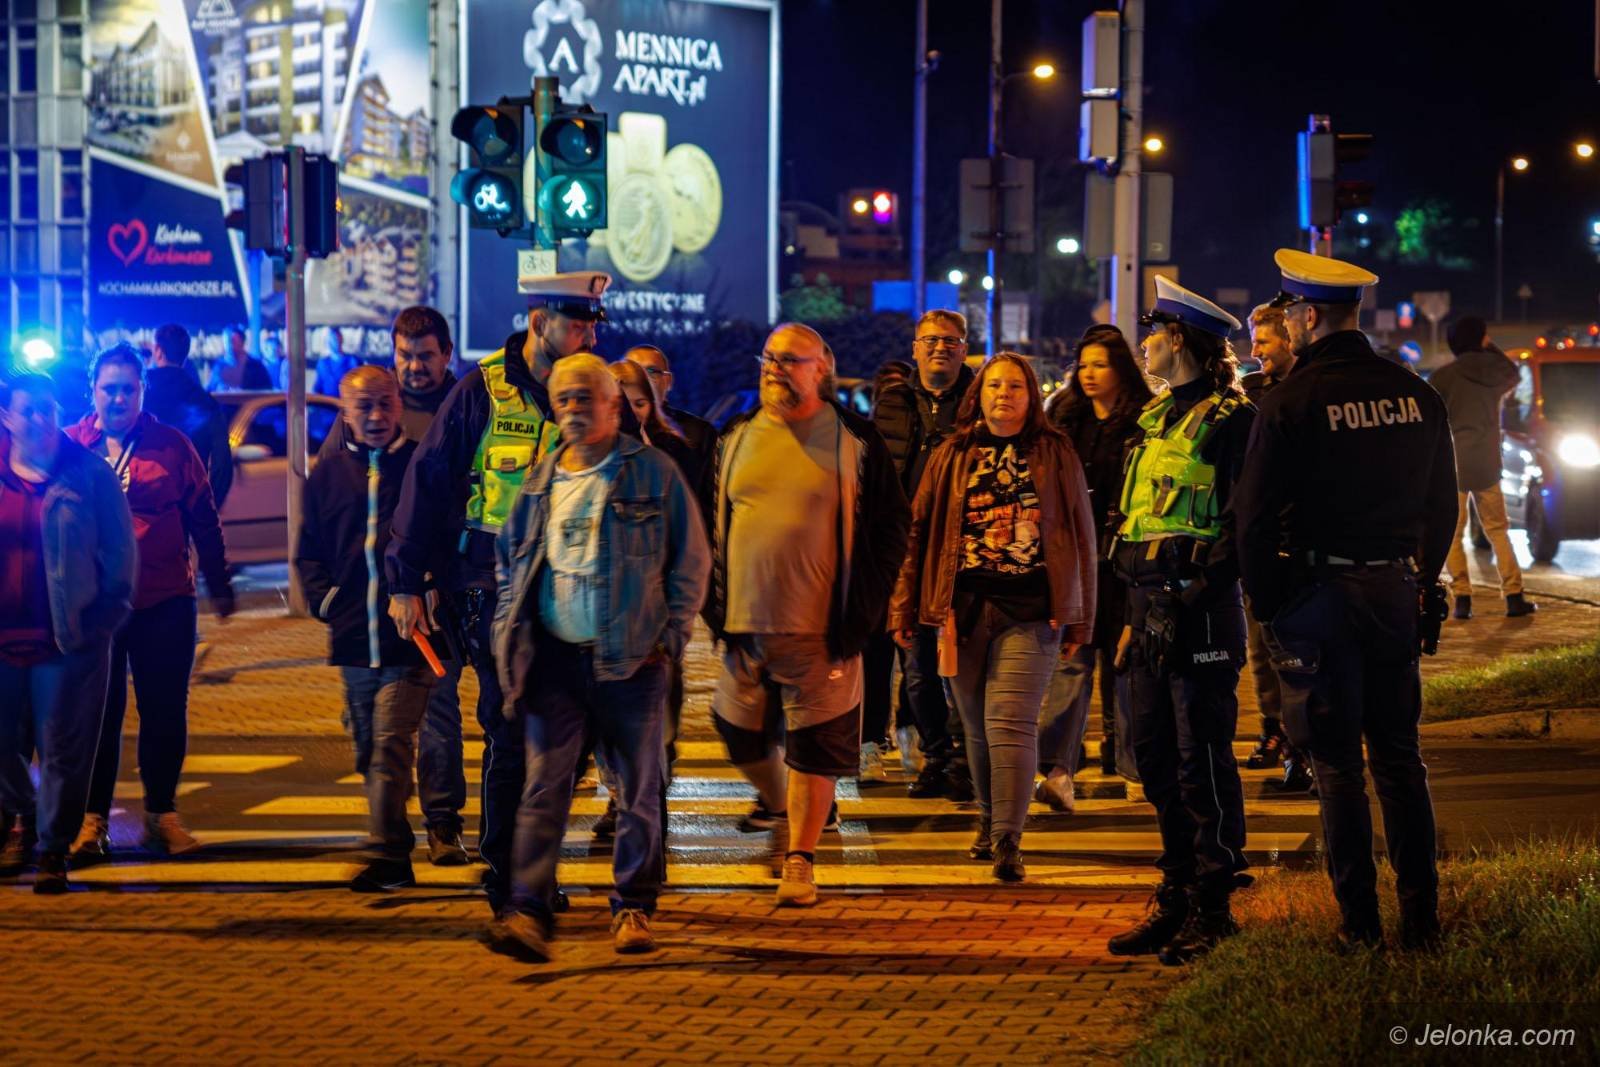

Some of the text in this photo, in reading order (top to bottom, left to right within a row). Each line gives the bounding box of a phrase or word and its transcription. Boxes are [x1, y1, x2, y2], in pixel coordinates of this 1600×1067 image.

[615, 29, 723, 72] MENNICA
[1326, 396, 1424, 431] POLICJA
[496, 420, 536, 434] POLICJA
[1192, 650, 1230, 665] POLICJA
